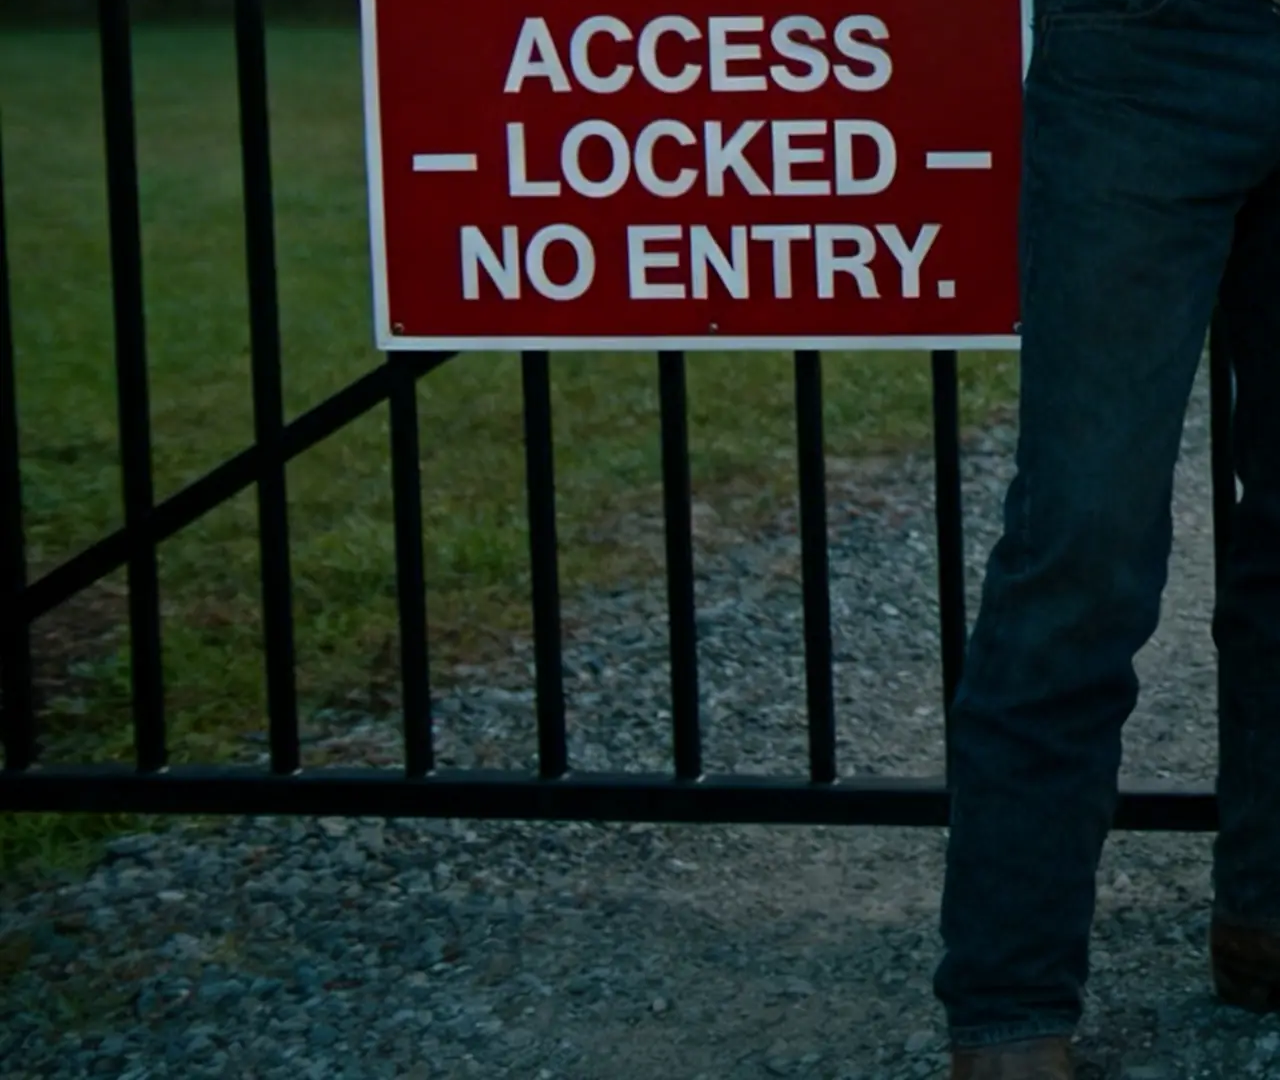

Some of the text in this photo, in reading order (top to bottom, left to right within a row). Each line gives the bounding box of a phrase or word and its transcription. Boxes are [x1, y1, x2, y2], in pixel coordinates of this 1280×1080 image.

[503, 14, 893, 94] ACCESS
[505, 119, 898, 198] LOCKED
[460, 223, 957, 301] NO ENTRY.
